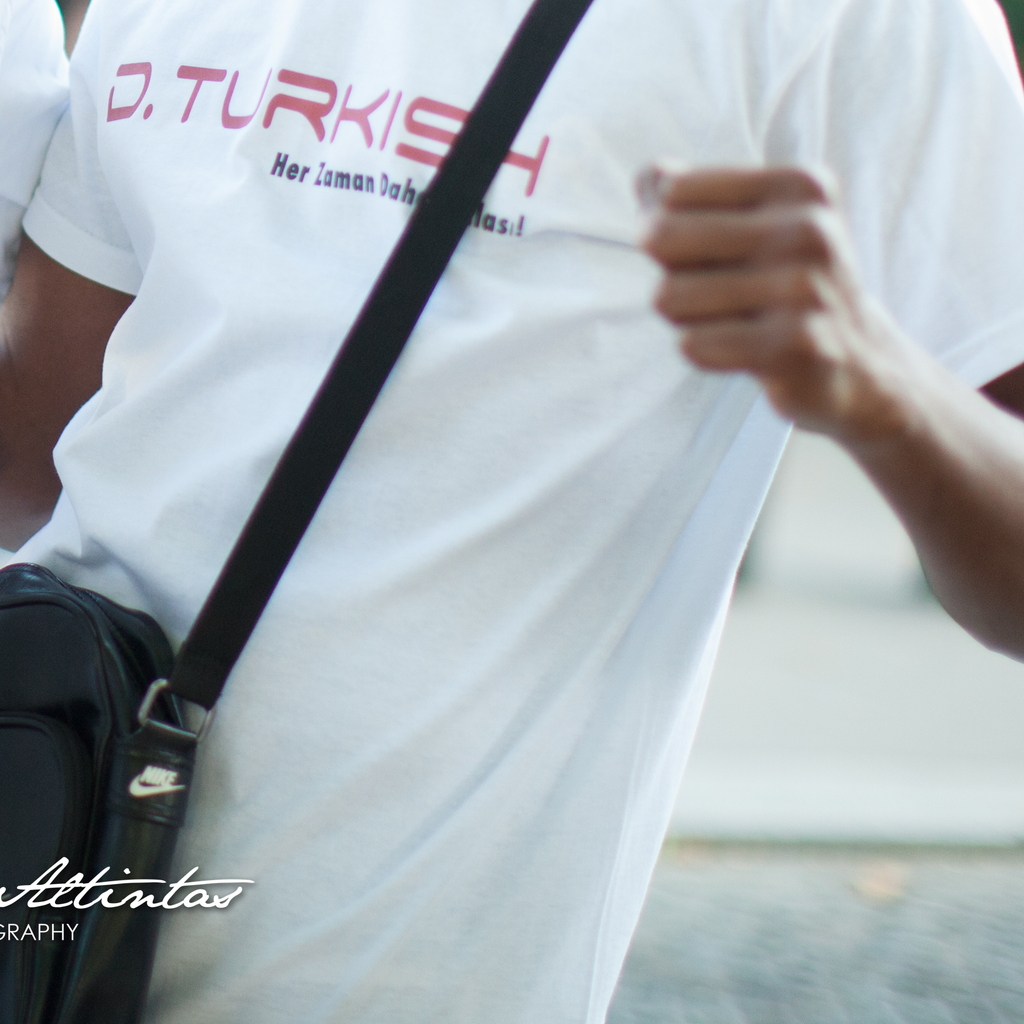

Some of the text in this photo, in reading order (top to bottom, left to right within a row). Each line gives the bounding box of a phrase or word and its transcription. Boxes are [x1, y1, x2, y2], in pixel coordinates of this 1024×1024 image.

[269, 152, 311, 184] Her
[313, 161, 375, 194] Zaman
[379, 171, 421, 206] Dah
[138, 764, 179, 788] NIKE
